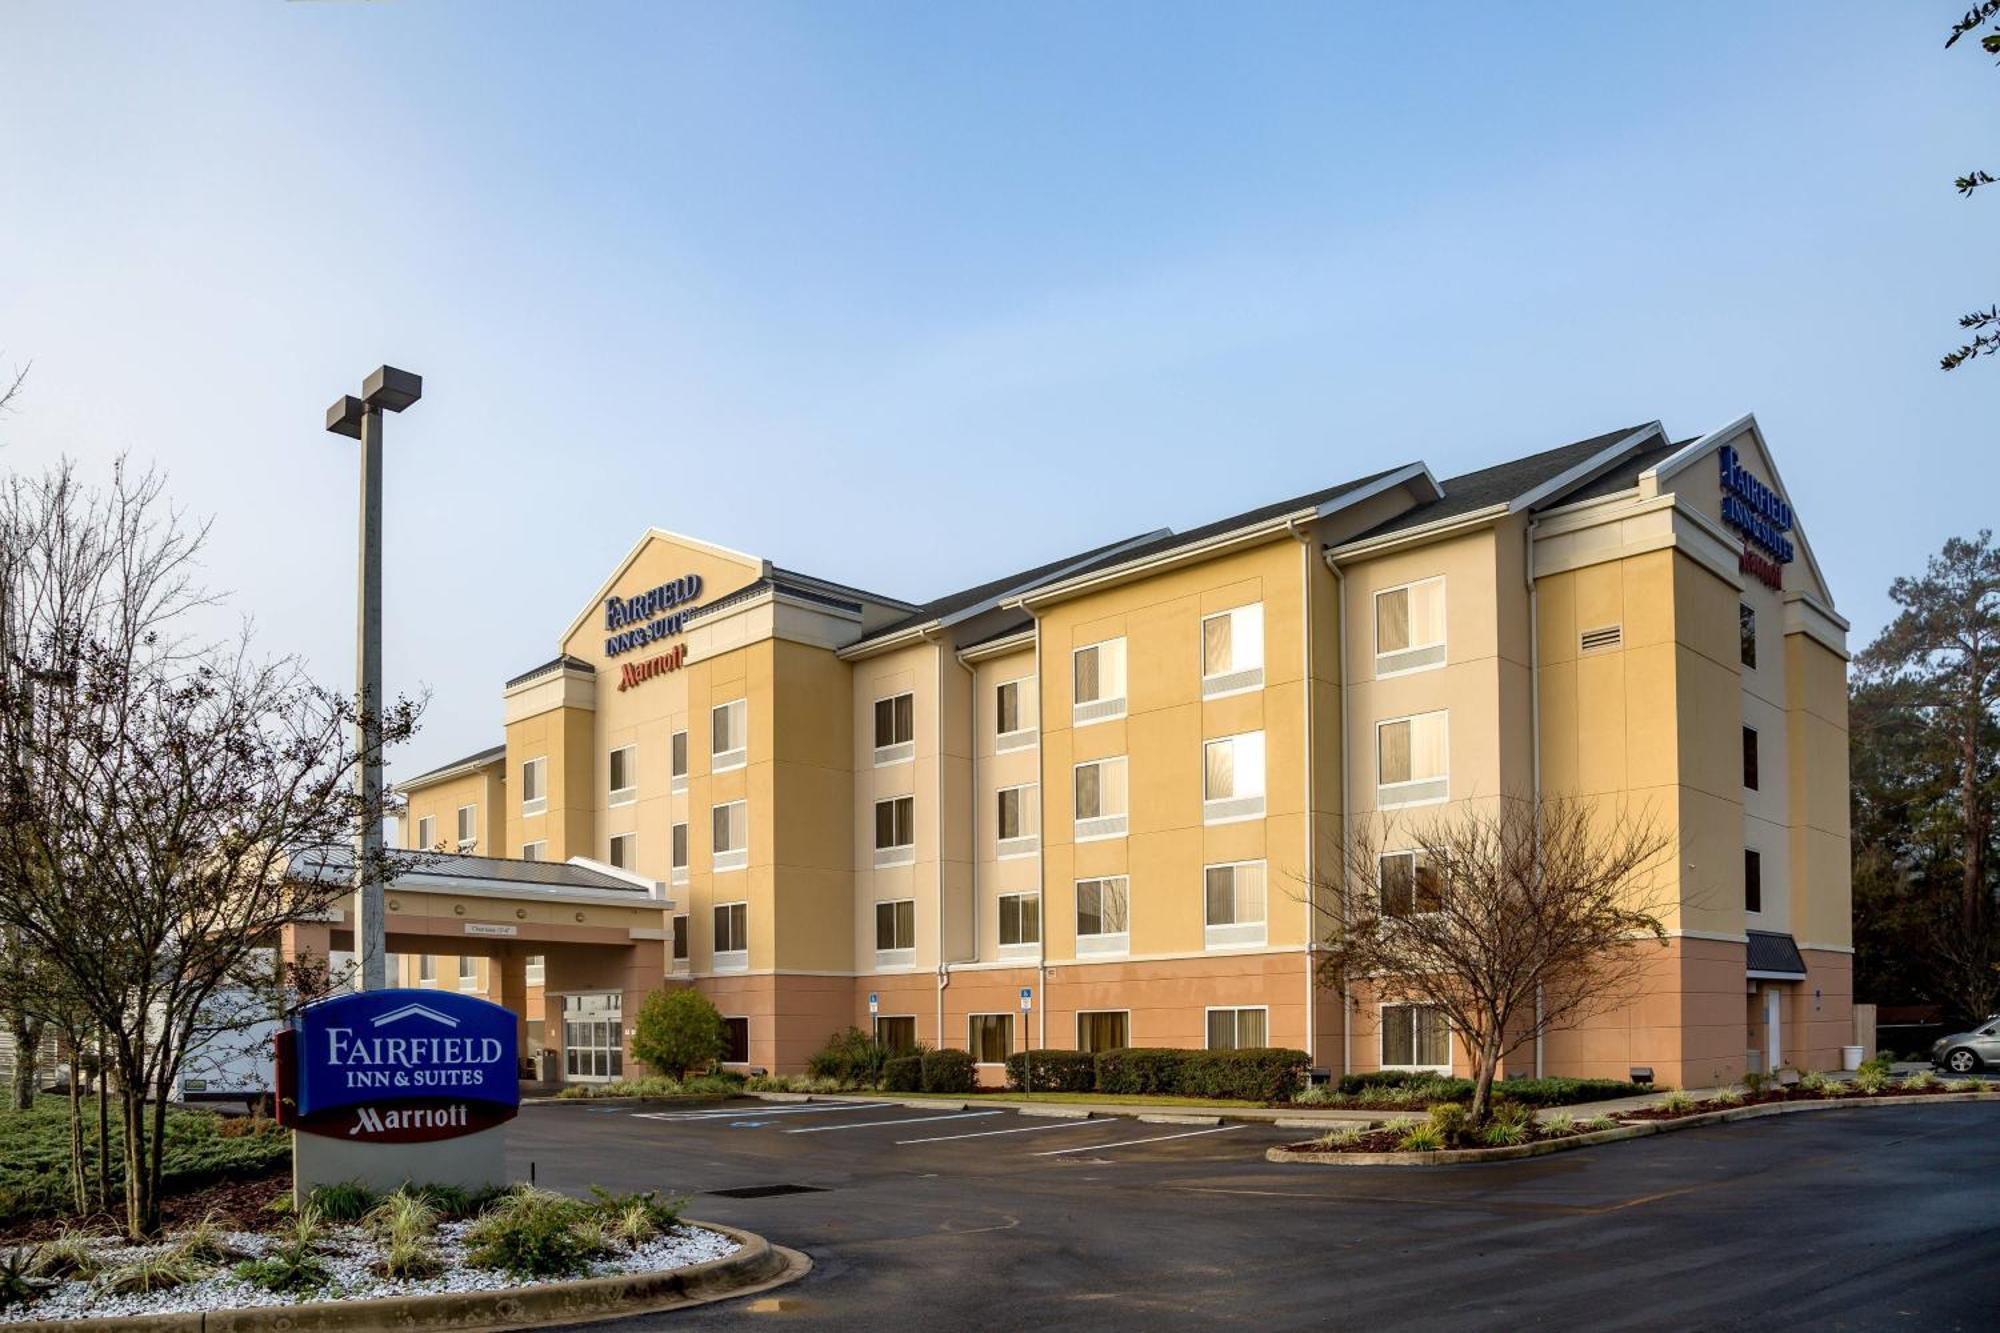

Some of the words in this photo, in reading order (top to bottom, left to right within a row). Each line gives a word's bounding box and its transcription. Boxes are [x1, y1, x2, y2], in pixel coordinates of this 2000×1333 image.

[604, 574, 703, 632] FAIRFIELD
[604, 632, 634, 658] INN
[632, 627, 648, 646] &
[617, 643, 687, 693] Marriott
[325, 1027, 503, 1068] FAIRFIELD
[346, 1071, 390, 1088] INN
[394, 1071, 411, 1087] &
[414, 1070, 484, 1087] SUITES
[349, 1104, 468, 1136] Marriott
